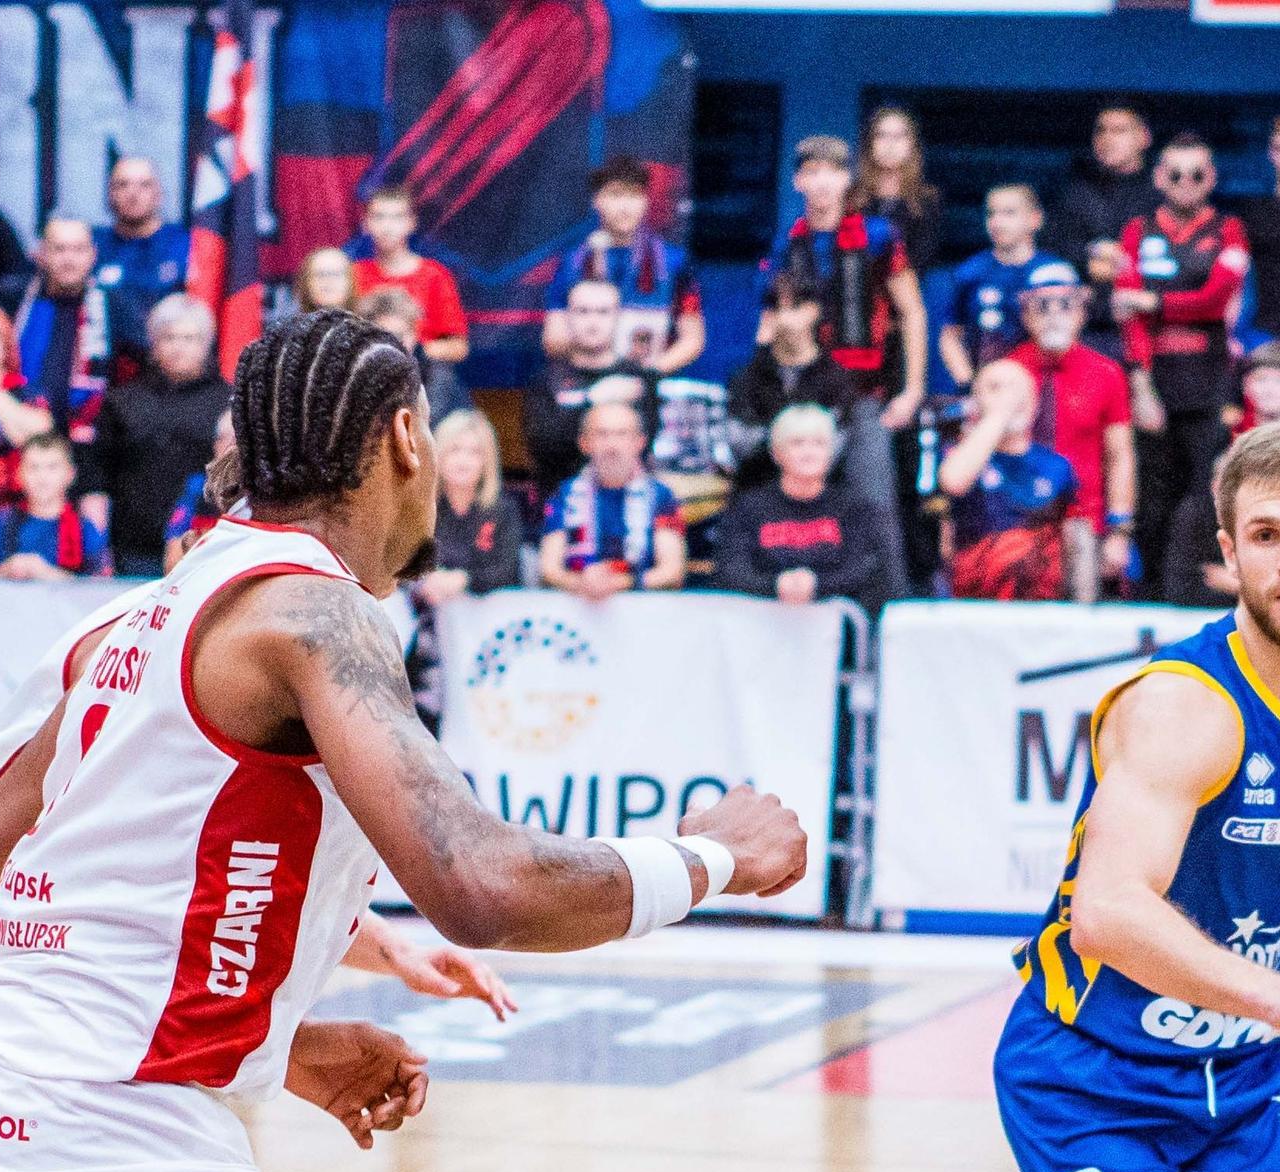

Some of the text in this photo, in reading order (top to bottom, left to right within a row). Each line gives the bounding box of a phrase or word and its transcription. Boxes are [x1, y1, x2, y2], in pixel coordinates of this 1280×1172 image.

[455, 772, 756, 838] WIPO
[8, 921, 72, 949] SŁUPSK
[206, 840, 280, 998] CZARNI
